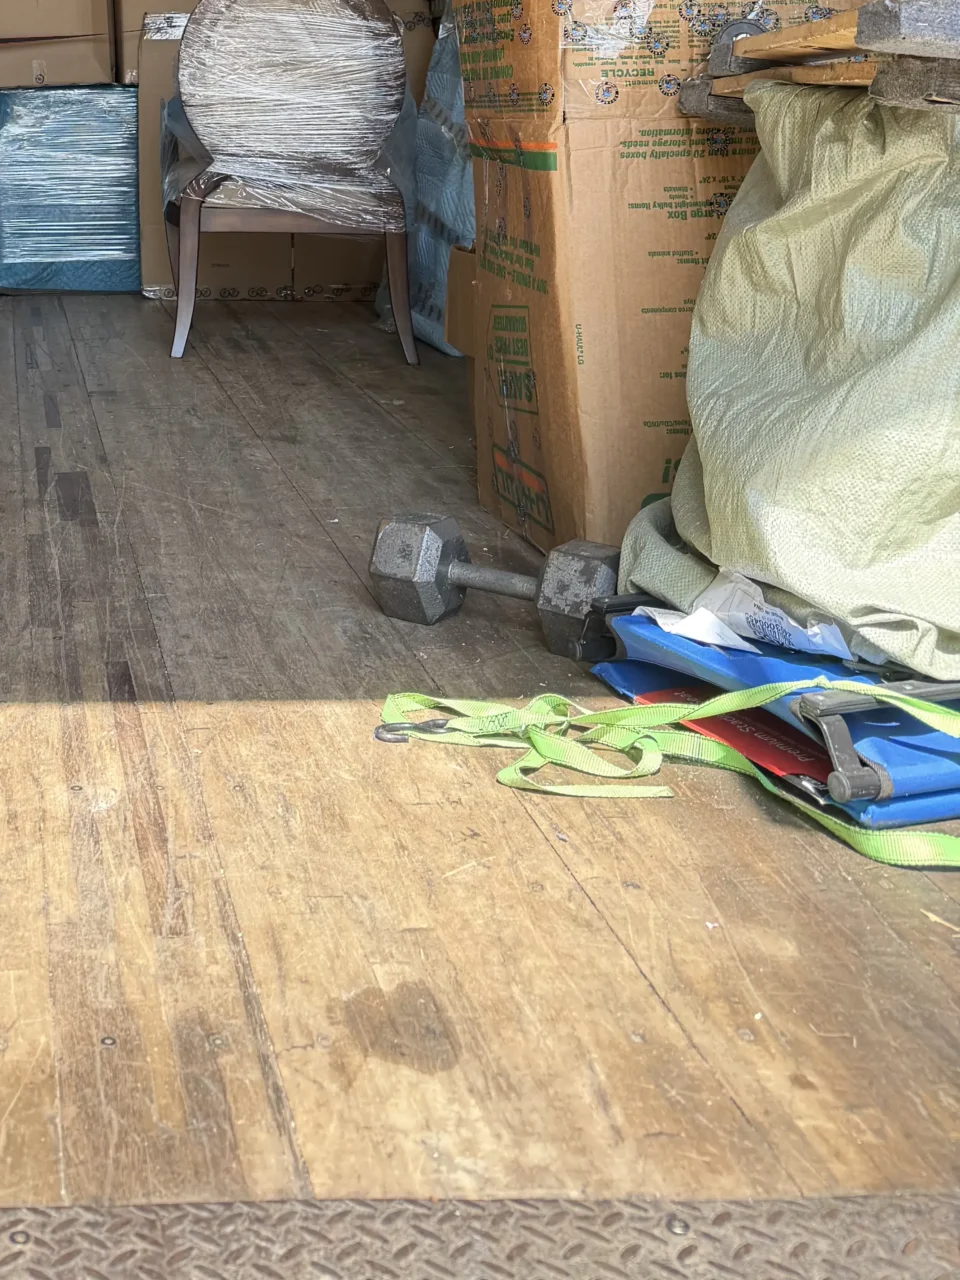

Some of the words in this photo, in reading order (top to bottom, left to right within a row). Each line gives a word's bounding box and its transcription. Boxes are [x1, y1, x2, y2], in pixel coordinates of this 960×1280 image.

[601, 68, 655, 78] RECYCLE
[638, 128, 694, 138] information.
[620, 140, 650, 149] needs.
[651, 137, 687, 148] storage
[688, 138, 705, 147] and
[620, 151, 647, 160] boxes
[650, 149, 691, 160] specialty
[694, 150, 705, 158] 20
[732, 149, 756, 157] more
[698, 176, 711, 184] 24"
[627, 202, 651, 210] items:
[652, 201, 673, 210] bulky
[667, 210, 687, 220] Box
[672, 250, 694, 258] Stuffed
[683, 298, 697, 306] Toys
[577, 355, 585, 365] LG
[660, 372, 673, 380] for:
[666, 428, 689, 436] items:
[754, 731, 814, 762] Premium
